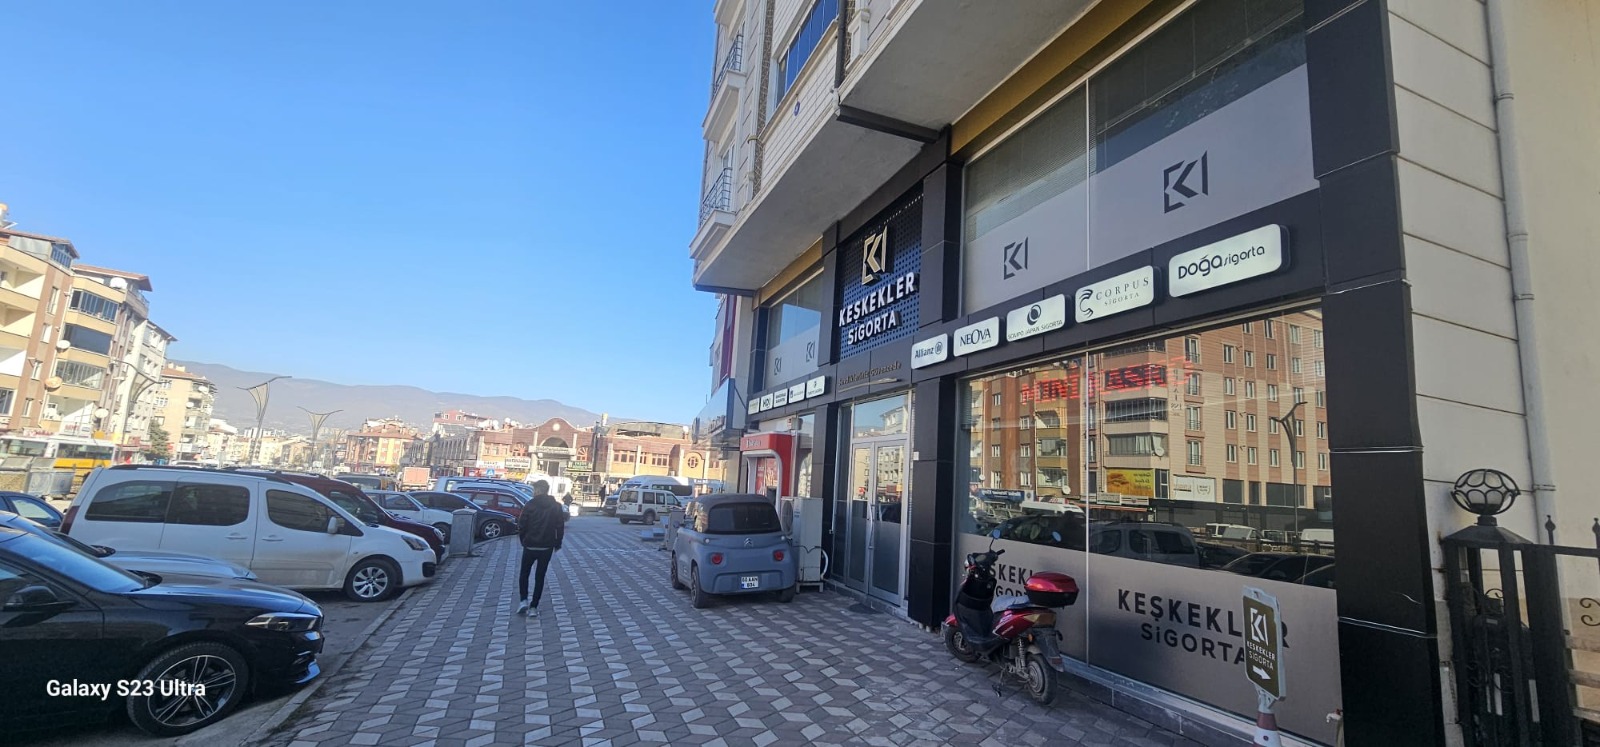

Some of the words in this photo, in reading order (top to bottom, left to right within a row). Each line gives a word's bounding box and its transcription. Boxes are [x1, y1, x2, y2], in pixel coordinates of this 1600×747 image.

[838, 271, 915, 327] KEŞKEKLER
[1095, 276, 1149, 301] CORPUS
[914, 346, 934, 359] Allianz
[1118, 588, 1290, 648] KEŞKEKLR
